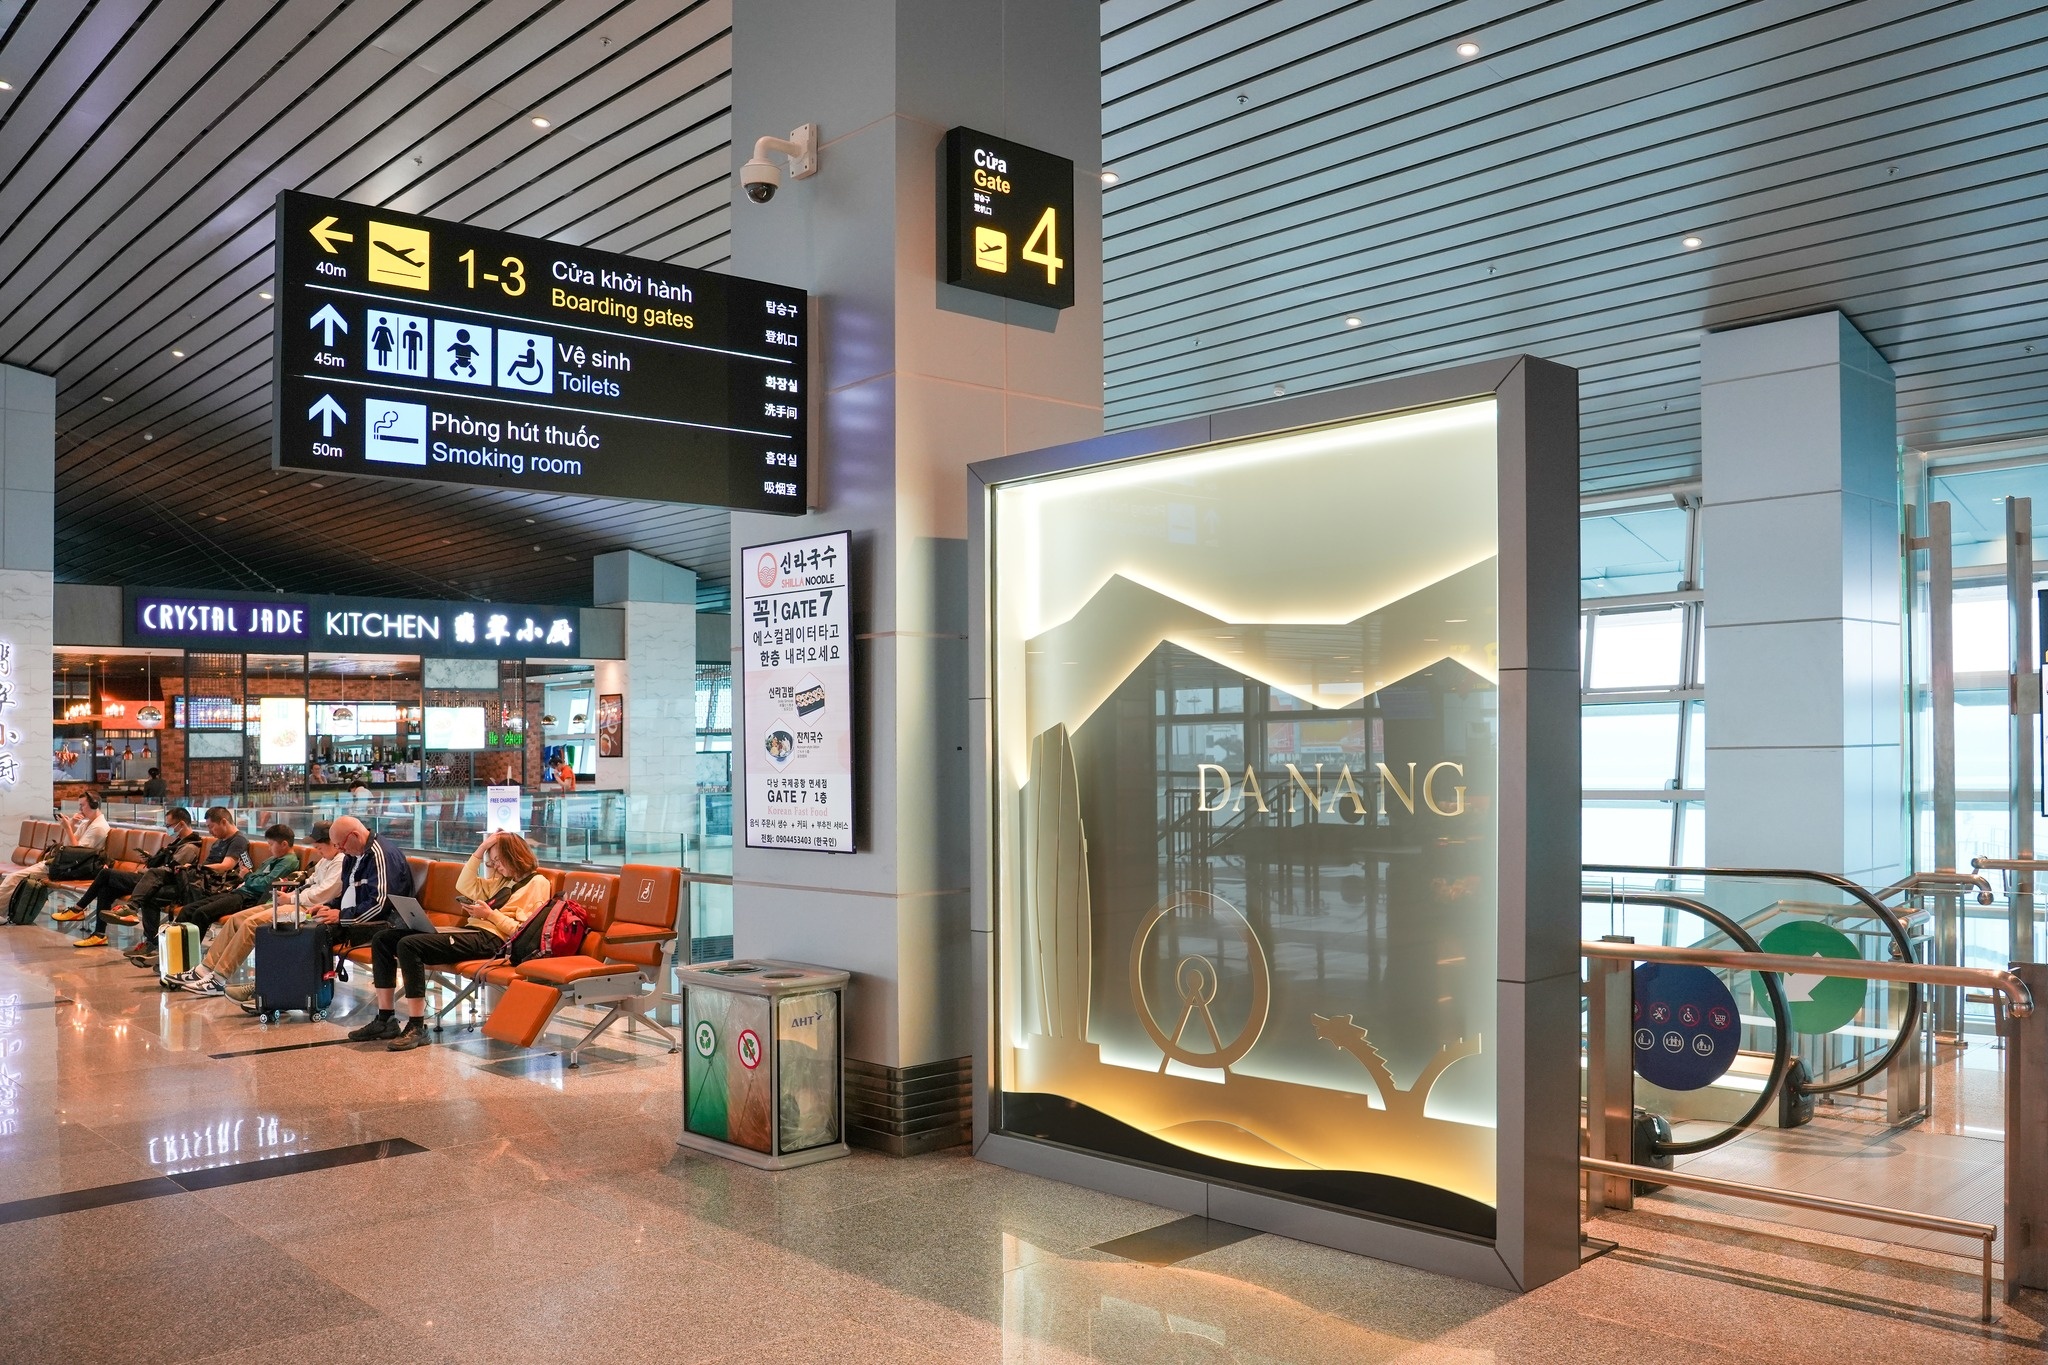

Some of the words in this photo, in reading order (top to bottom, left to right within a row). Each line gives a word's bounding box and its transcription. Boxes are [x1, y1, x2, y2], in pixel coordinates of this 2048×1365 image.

[974, 149, 1007, 174] Cửa
[974, 169, 1011, 194] Gate
[1023, 207, 1063, 285] 4
[316, 261, 347, 278] 40m
[458, 249, 526, 297] 1-3
[552, 260, 594, 287] Cửa
[602, 269, 641, 294] khởi
[648, 278, 693, 303] hành
[552, 289, 638, 324] Boarding
[644, 308, 694, 329] gates
[765, 299, 798, 318] 탑승구
[765, 329, 798, 347] 登机口
[314, 352, 345, 368] 45m
[558, 343, 586, 368] Vệ
[592, 348, 631, 372] sinh
[558, 371, 620, 397] Toilets
[765, 375, 798, 393] 화장실
[764, 403, 797, 420] 洗手间
[431, 411, 500, 443] Phòng
[507, 422, 539, 443] hút
[545, 426, 600, 449] thuốc
[312, 443, 343, 458] 50m
[432, 443, 524, 474] Smoking
[531, 455, 582, 475] room
[764, 451, 798, 468] 흡연실
[764, 481, 797, 497] 吸烟室
[780, 545, 837, 575] 신라국수
[781, 578, 804, 589] SHILLA
[805, 573, 835, 587] NOODLE
[752, 599, 778, 628] 꼭!
[781, 599, 817, 621] GATE
[819, 590, 833, 617] 7
[143, 603, 238, 632] CRYSTAL
[248, 608, 304, 634] JADE
[326, 611, 440, 640] KITCHEN
[760, 650, 780, 667] 한층
[785, 645, 840, 664] 내려오세요
[768, 686, 794, 699] 신라김밥
[796, 731, 823, 744] 잔치국수
[767, 779, 779, 788] 다낭
[767, 789, 797, 803] GATE
[801, 790, 807, 803] 7
[814, 792, 827, 804] 1층
[767, 805, 792, 816] Korean
[794, 806, 808, 816] Fast
[810, 807, 828, 817] Food
[791, 1015, 815, 1028] AHT
